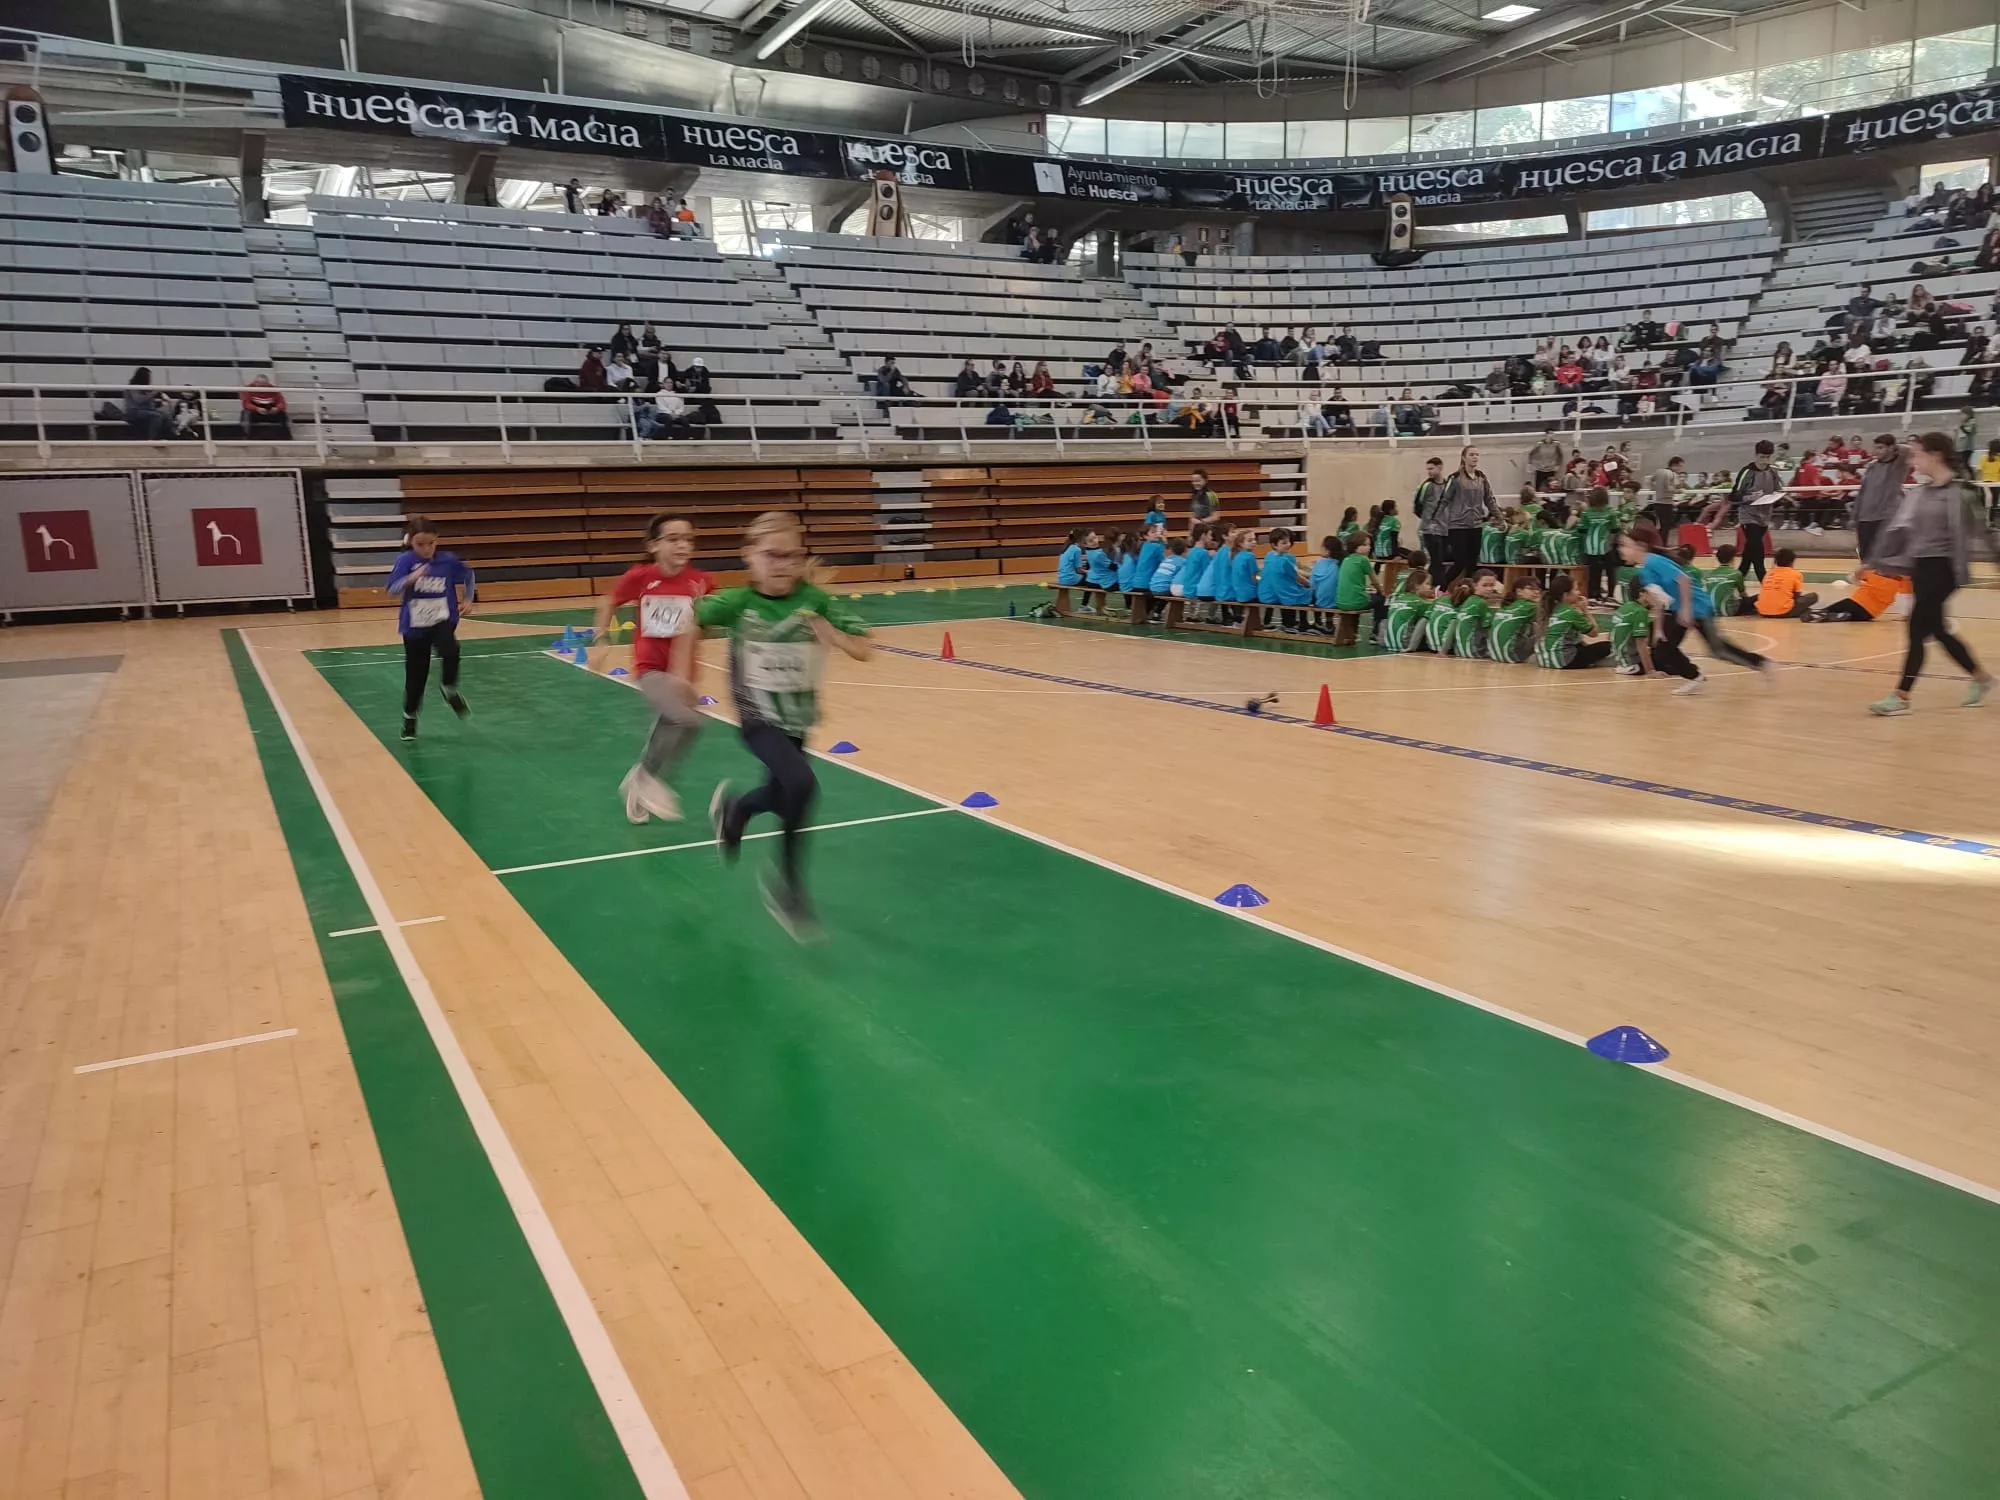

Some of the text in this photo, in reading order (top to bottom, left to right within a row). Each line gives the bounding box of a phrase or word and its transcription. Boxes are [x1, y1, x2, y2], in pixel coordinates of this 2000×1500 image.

[1068, 165, 1158, 186] Ayuntamiento
[1069, 183, 1139, 201] de Huesca
